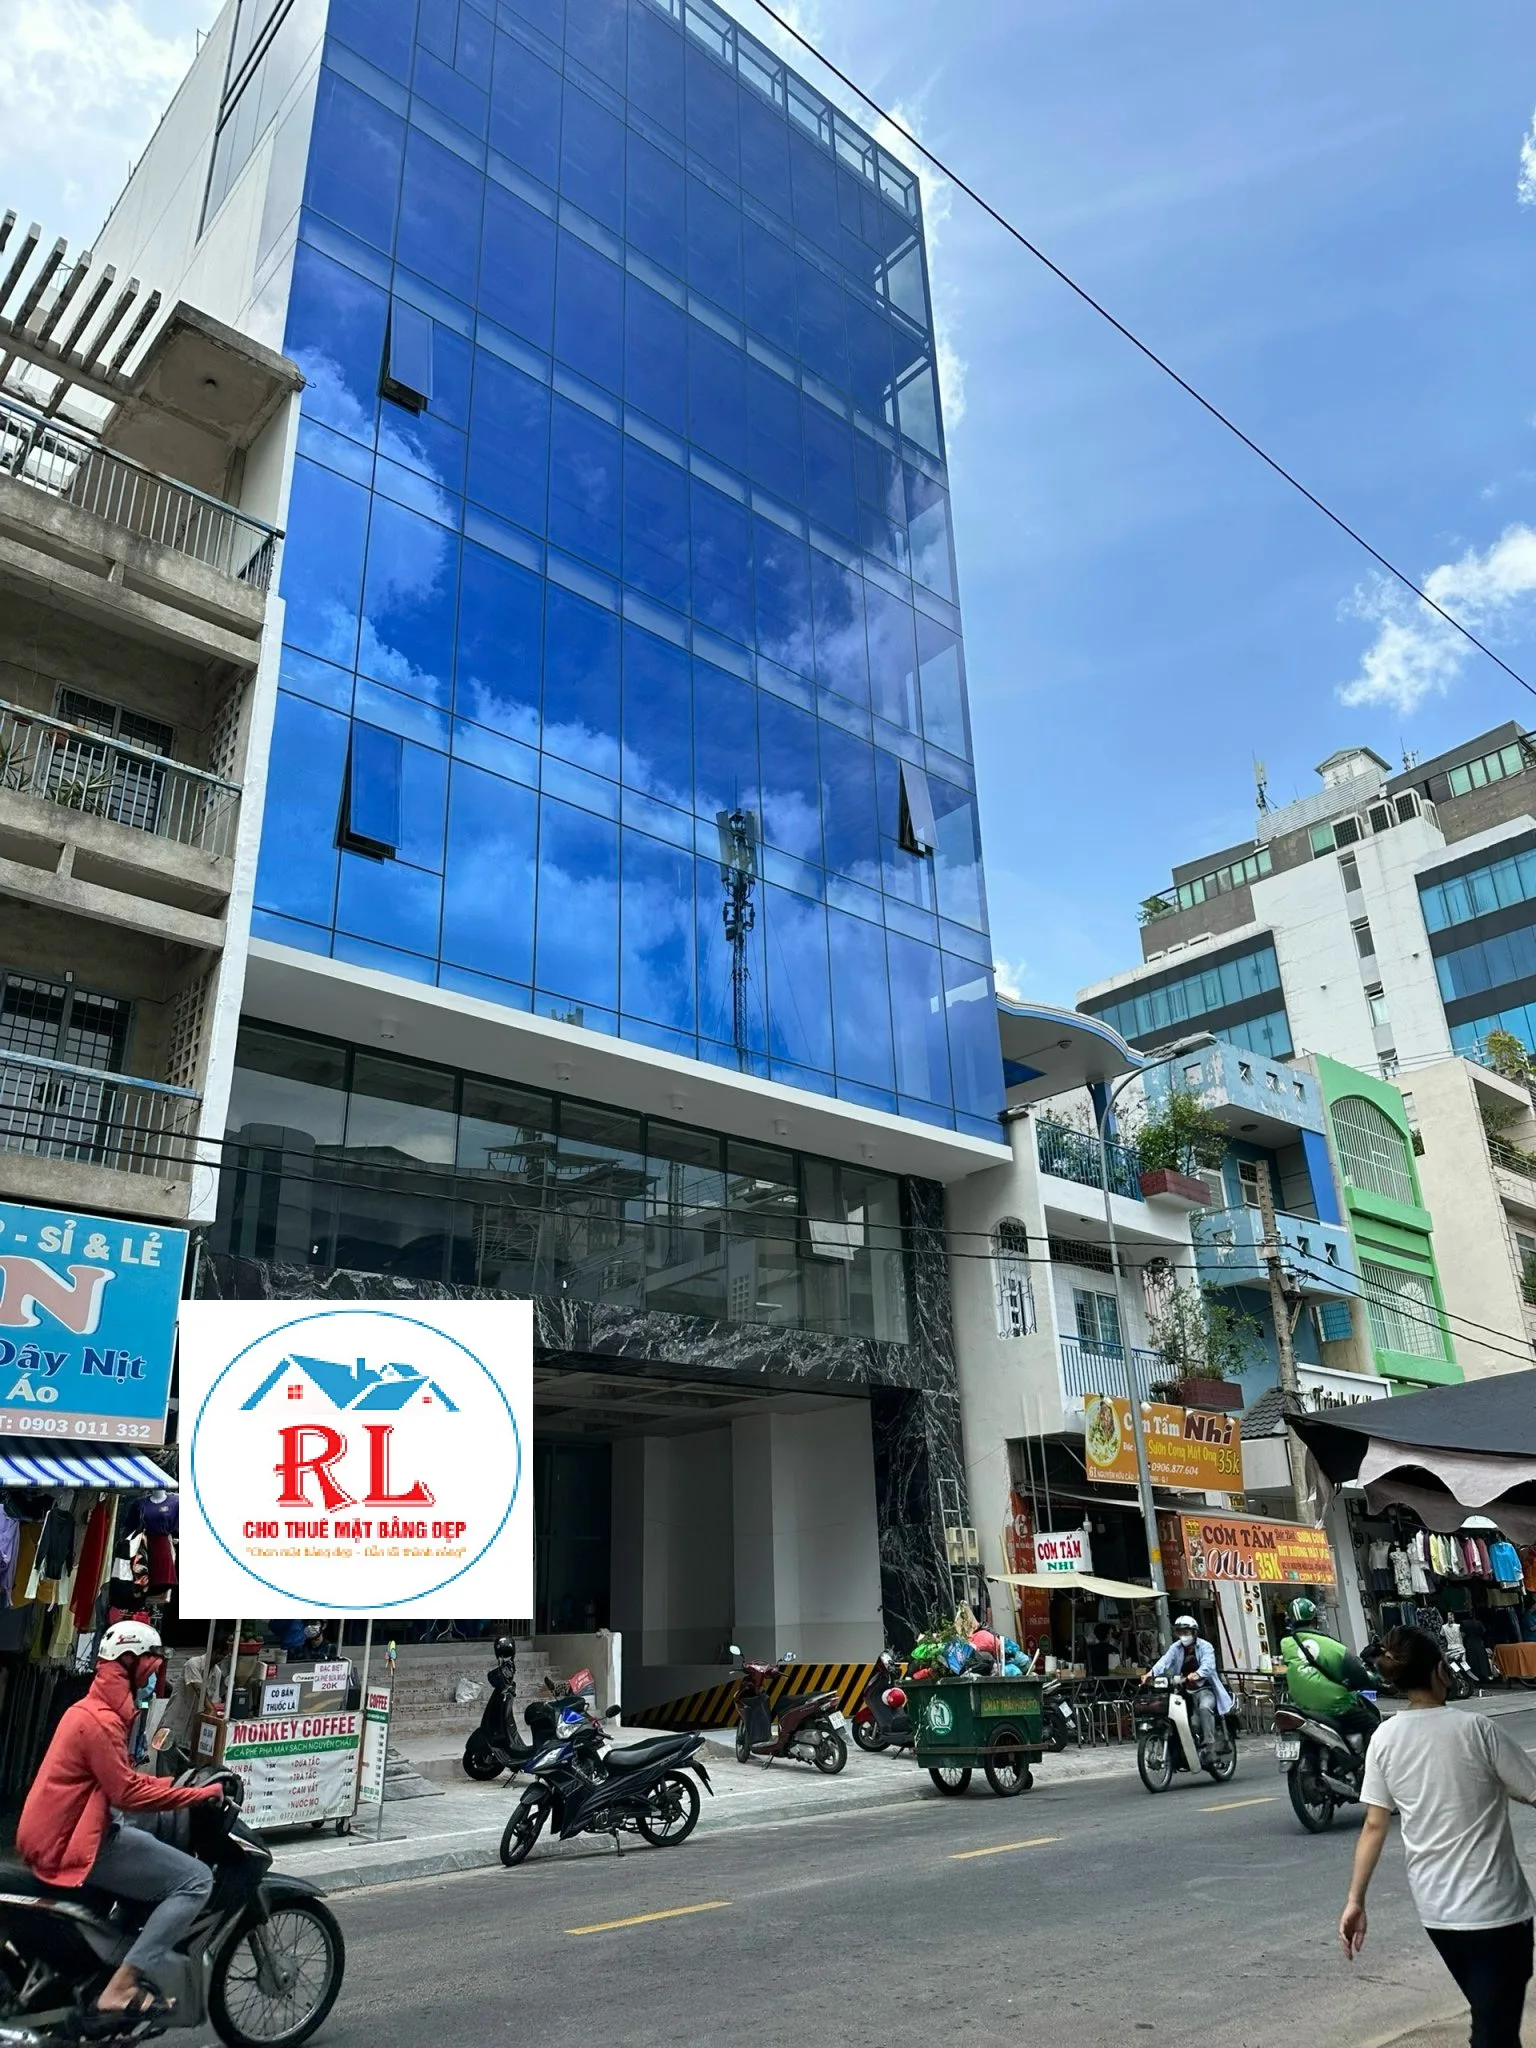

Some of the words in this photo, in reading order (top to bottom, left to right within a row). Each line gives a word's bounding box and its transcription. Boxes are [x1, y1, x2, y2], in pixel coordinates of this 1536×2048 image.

[38, 1220, 77, 1255] SỈ
[83, 1233, 110, 1260] &
[120, 1232, 163, 1267] LẺ
[81, 1346, 147, 1384] Nịt
[6, 1372, 59, 1403] Áo
[19, 1416, 68, 1433] 0903
[75, 1422, 108, 1436] 011
[116, 1423, 150, 1438] 332
[1123, 1412, 1150, 1433] Cm
[1153, 1414, 1180, 1437] Tấm
[1183, 1414, 1233, 1446] Nhi
[1151, 1462, 1199, 1475] 0906.877.604
[1037, 1538, 1058, 1560] CƠM
[1060, 1533, 1082, 1558] TẤM
[1202, 1524, 1238, 1547] CƠM
[1240, 1525, 1276, 1549] TẤM
[1047, 1561, 1075, 1571] NHI
[1208, 1548, 1257, 1579] Nhi
[1255, 1551, 1283, 1580] 35K
[271, 1689, 280, 1698] CÓ
[281, 1687, 294, 1697] BÁN
[321, 1682, 338, 1690] 20K
[266, 1700, 287, 1712] THUỐC
[287, 1702, 295, 1710] LÁ
[233, 1719, 299, 1744] MONKEY
[302, 1715, 356, 1738] COFFEE
[245, 1747, 258, 1756] PHÊ
[260, 1747, 272, 1755] PHA
[308, 1740, 335, 1751] NGUYÊN
